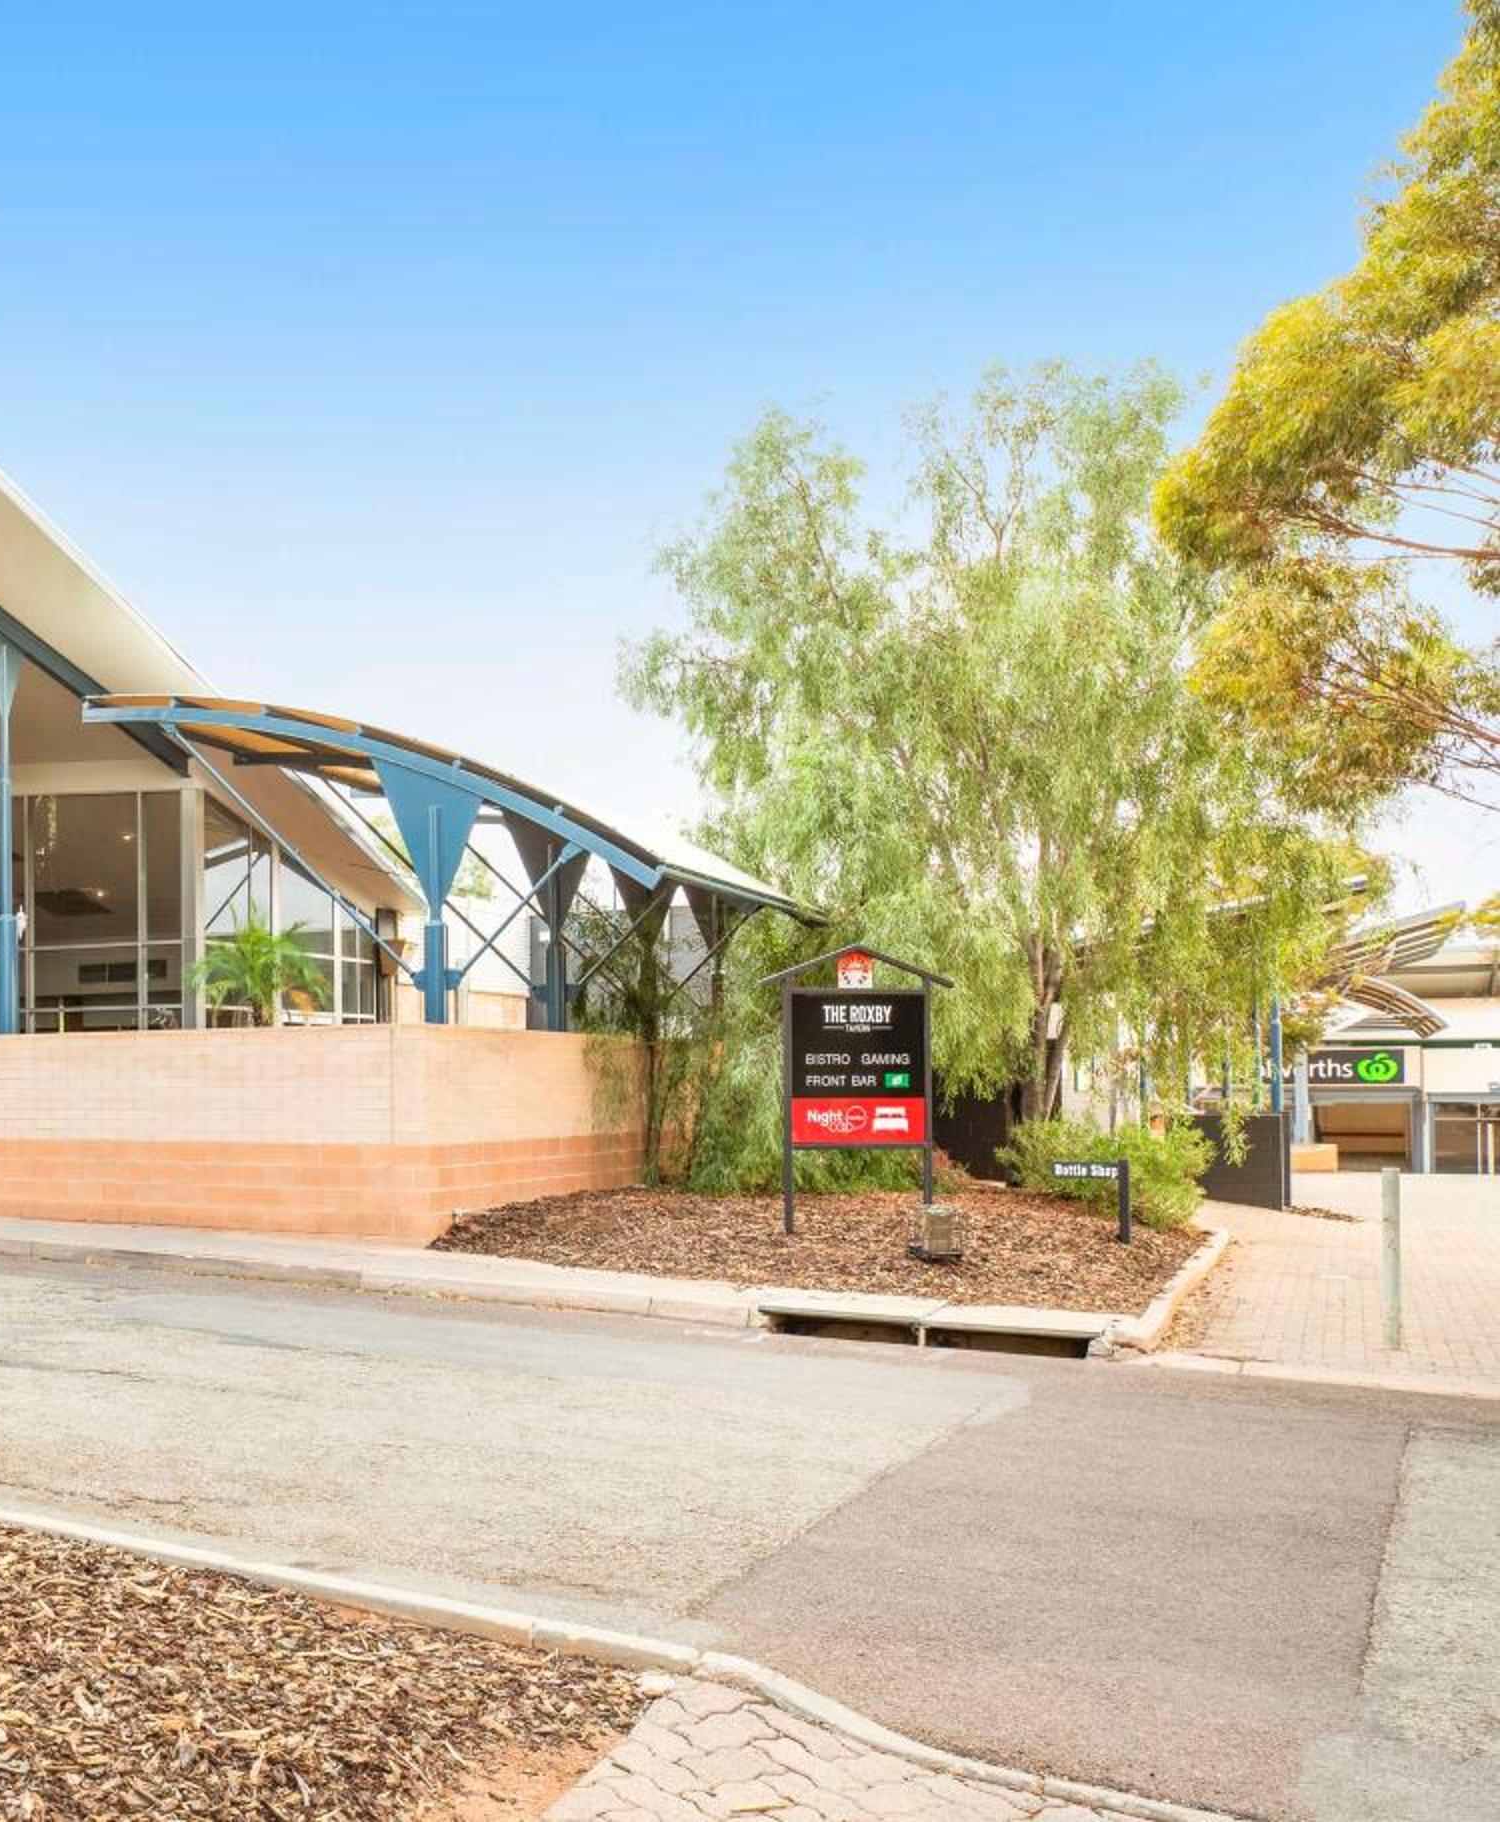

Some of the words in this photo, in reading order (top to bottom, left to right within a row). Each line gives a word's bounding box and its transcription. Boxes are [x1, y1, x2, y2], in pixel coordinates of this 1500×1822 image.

[822, 1005, 847, 1023] THE
[849, 1005, 892, 1023] ROXBY
[805, 1053, 851, 1065] BISTRO
[861, 1053, 911, 1065] GAMING
[805, 1075, 846, 1087] FRONT
[851, 1075, 876, 1087] BAR
[807, 1109, 843, 1126] Night
[1054, 1164, 1087, 1176] Bottle
[1091, 1164, 1119, 1179] Shop
